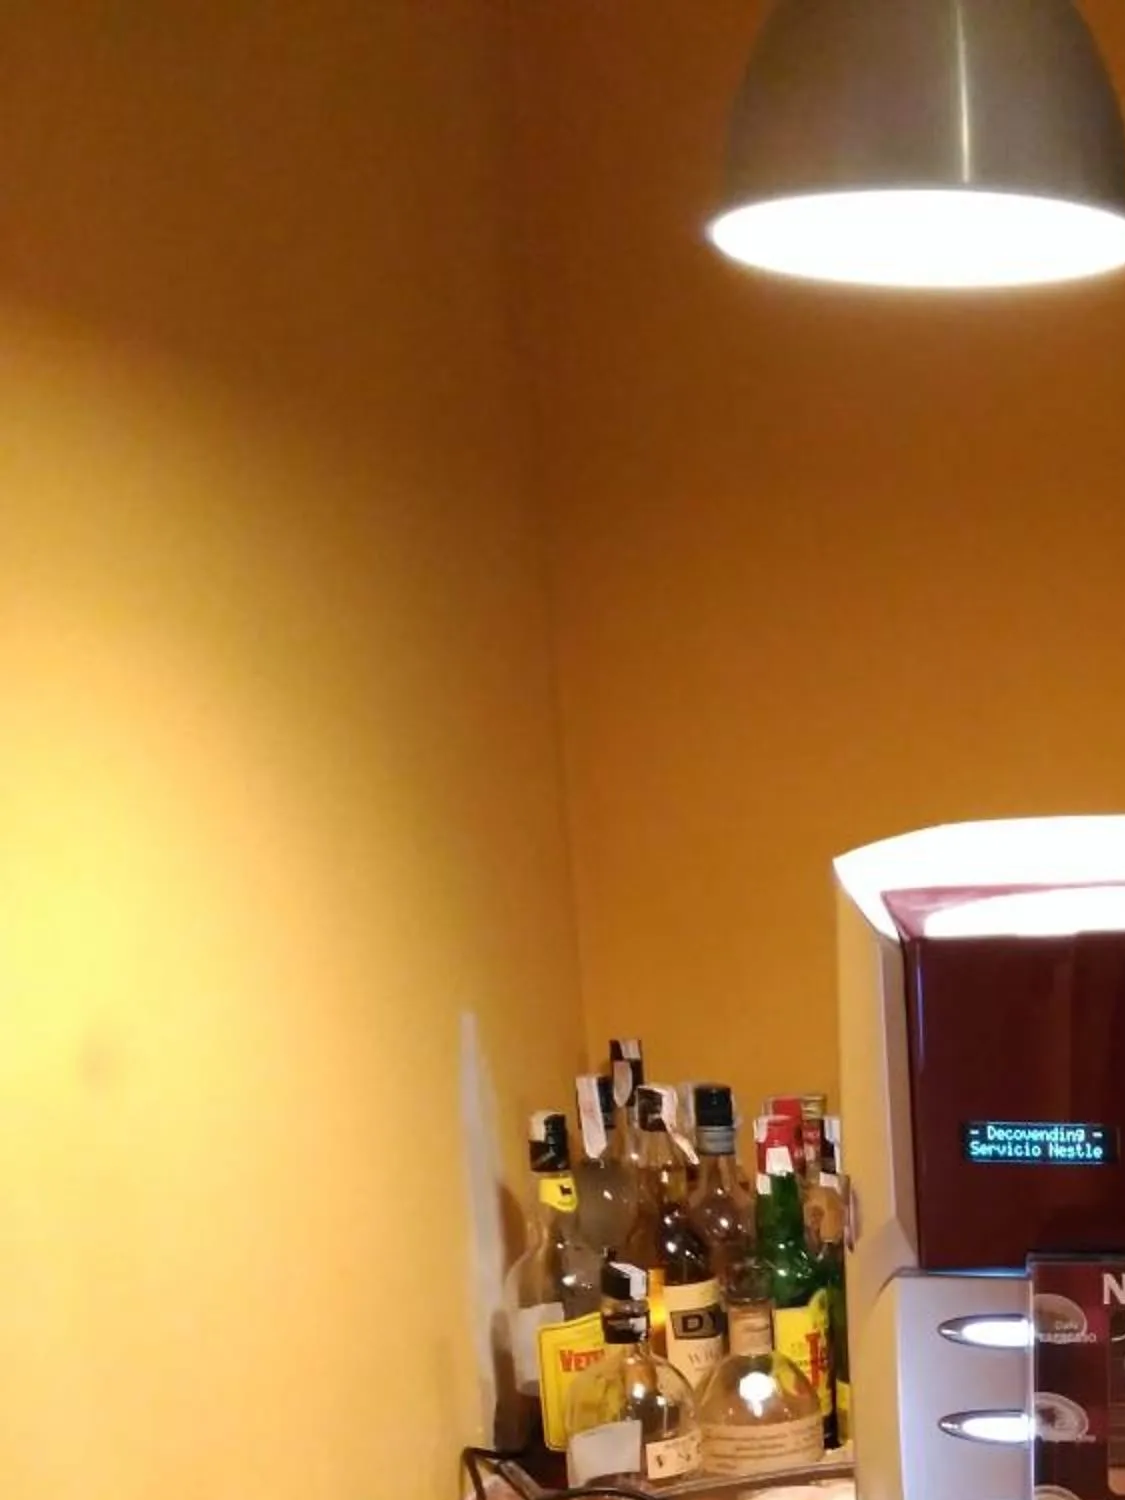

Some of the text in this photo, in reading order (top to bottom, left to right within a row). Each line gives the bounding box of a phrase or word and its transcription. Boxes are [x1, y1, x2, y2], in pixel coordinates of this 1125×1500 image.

[986, 1124, 1086, 1142] Decovending
[969, 1140, 1103, 1159] Servicio Nestle
